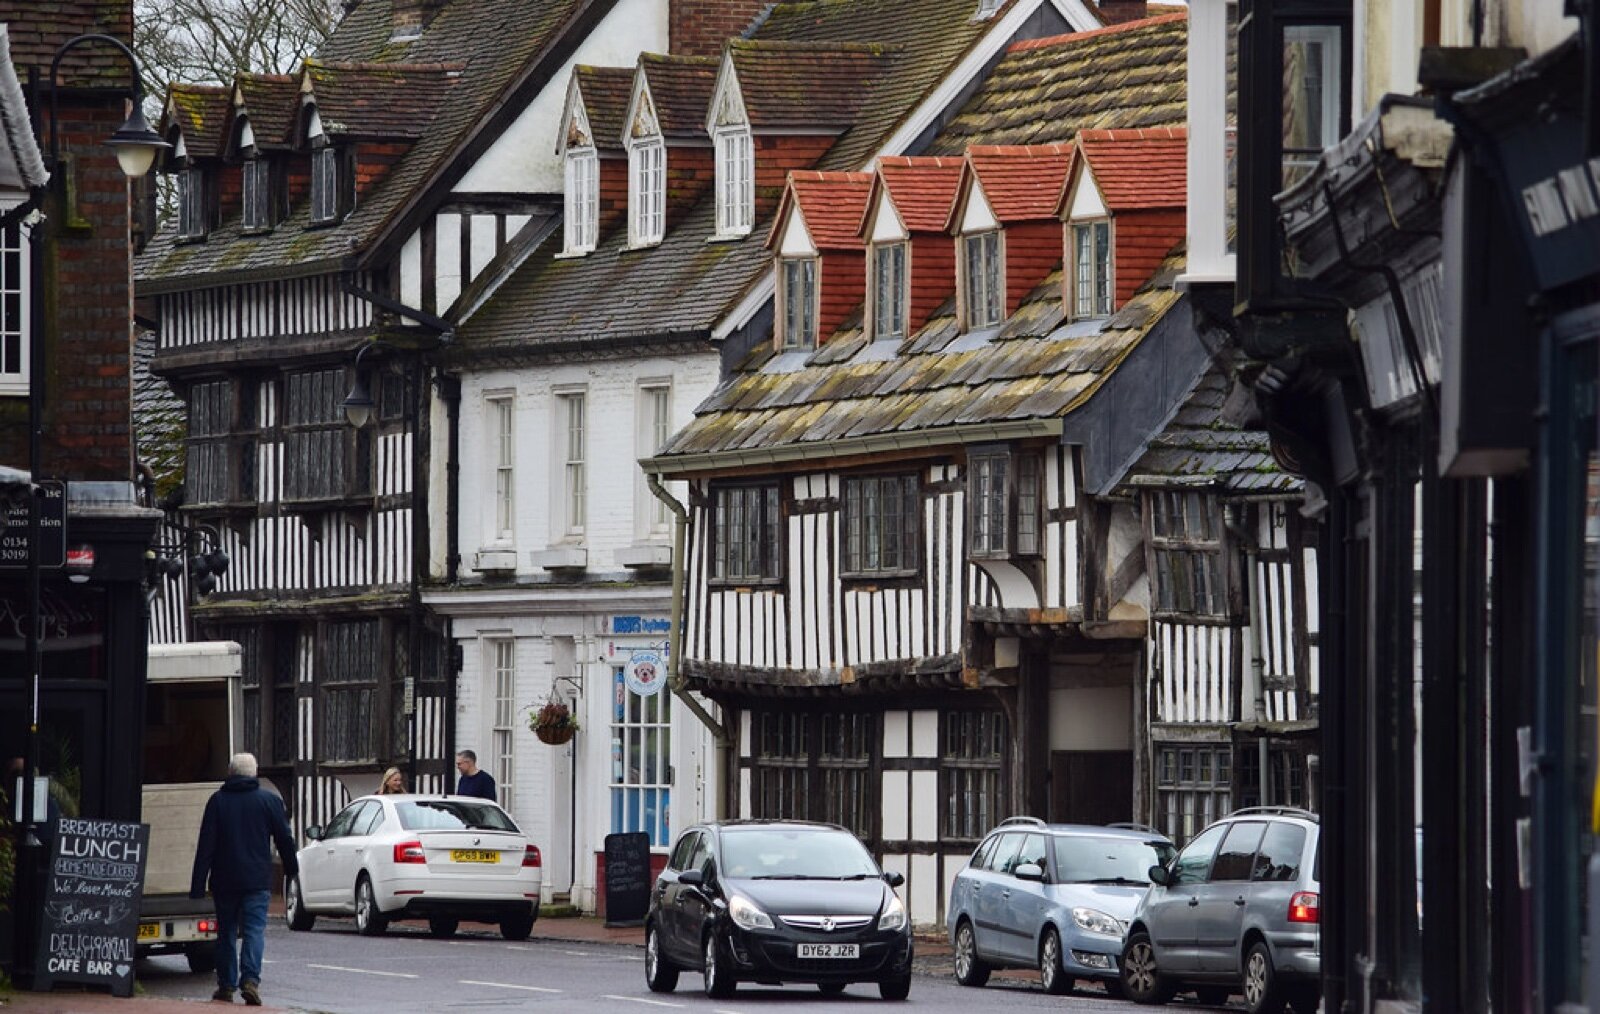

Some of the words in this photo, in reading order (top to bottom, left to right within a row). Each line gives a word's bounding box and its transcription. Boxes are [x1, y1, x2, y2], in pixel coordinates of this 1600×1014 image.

[59, 818, 140, 839] BREAKFAST
[60, 836, 141, 862] LUNCH
[55, 878, 71, 893] We
[802, 945, 832, 957] DY62
[833, 945, 856, 957] JZR
[86, 960, 113, 975] BAR
